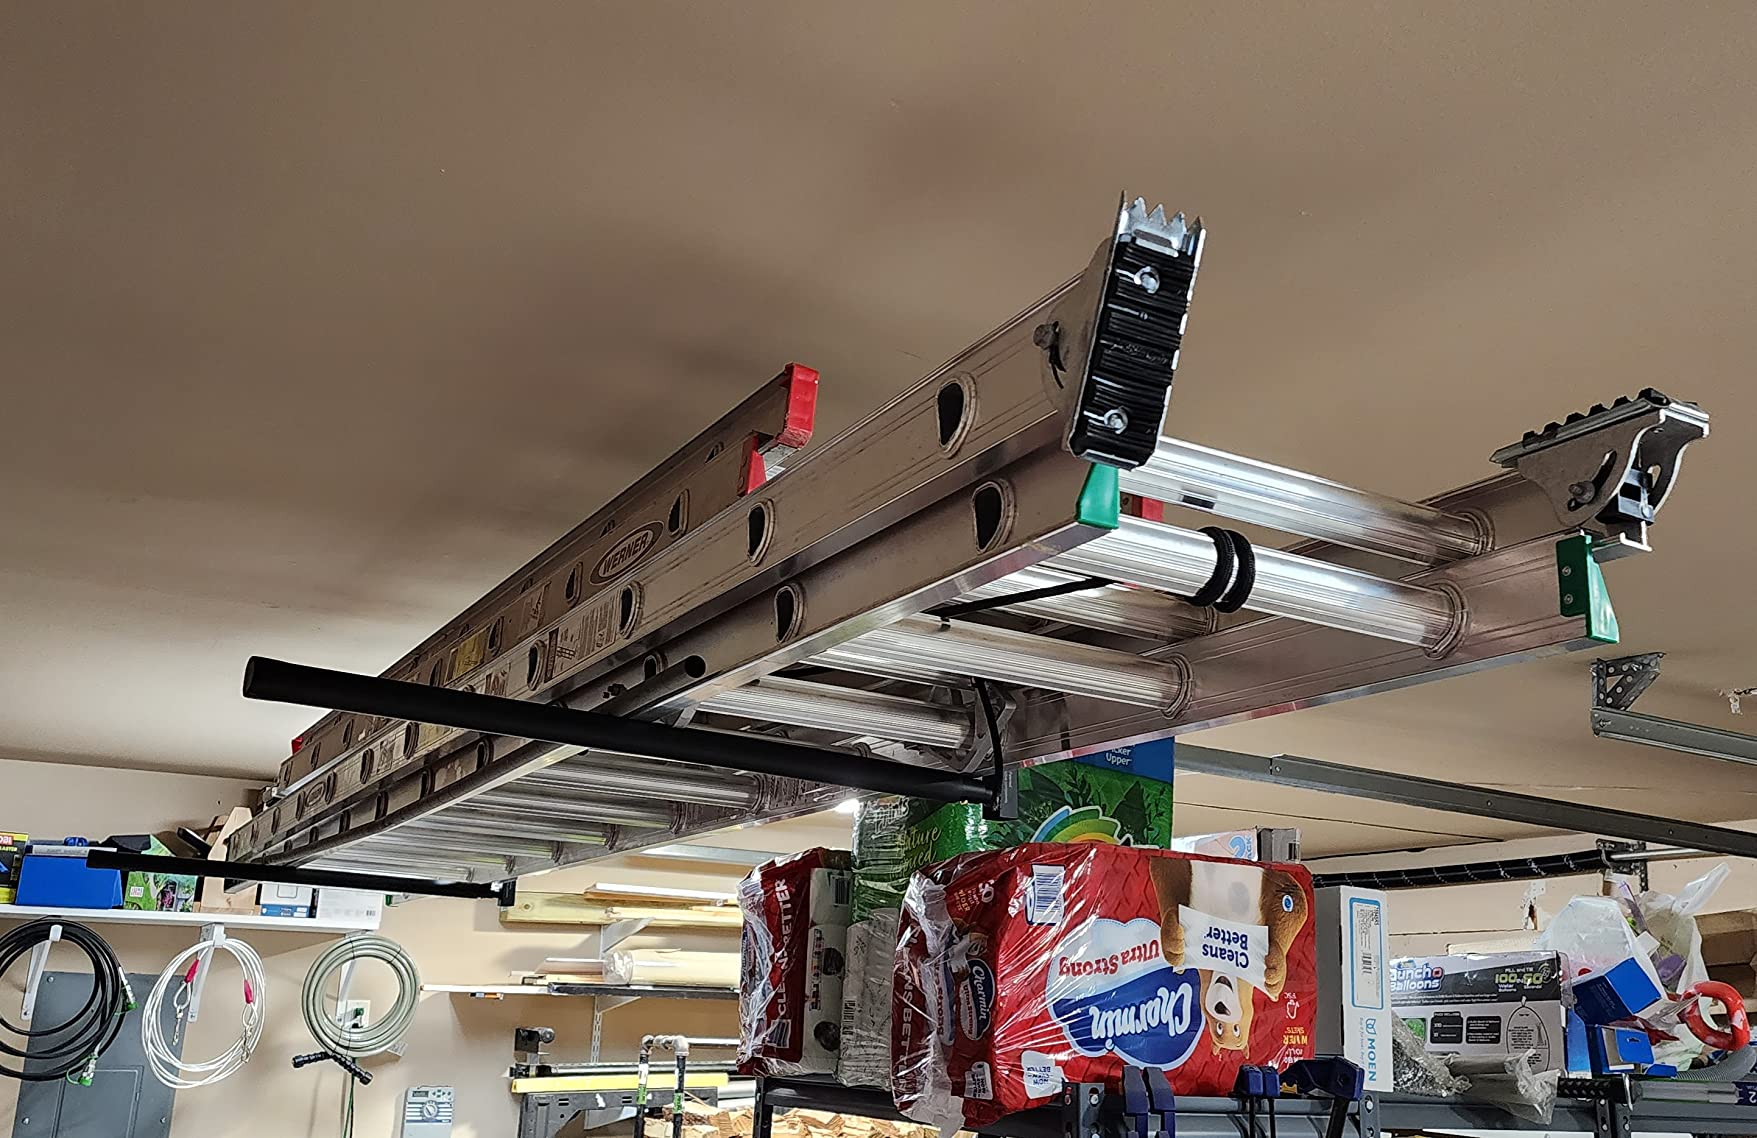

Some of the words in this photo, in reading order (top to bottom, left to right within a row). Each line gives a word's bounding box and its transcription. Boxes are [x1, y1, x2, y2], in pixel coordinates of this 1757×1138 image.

[602, 531, 651, 576] WERNER
[1105, 752, 1132, 766] Upper
[1204, 926, 1249, 951] Better
[1058, 954, 1119, 977] Strong
[1120, 939, 1160, 966] Ultra
[1201, 943, 1250, 969] Cleans
[1495, 972, 1518, 984] 100
[971, 964, 990, 1021] Charmin
[1088, 981, 1193, 1051] Charmin
[1367, 1038, 1377, 1082] MOEN
